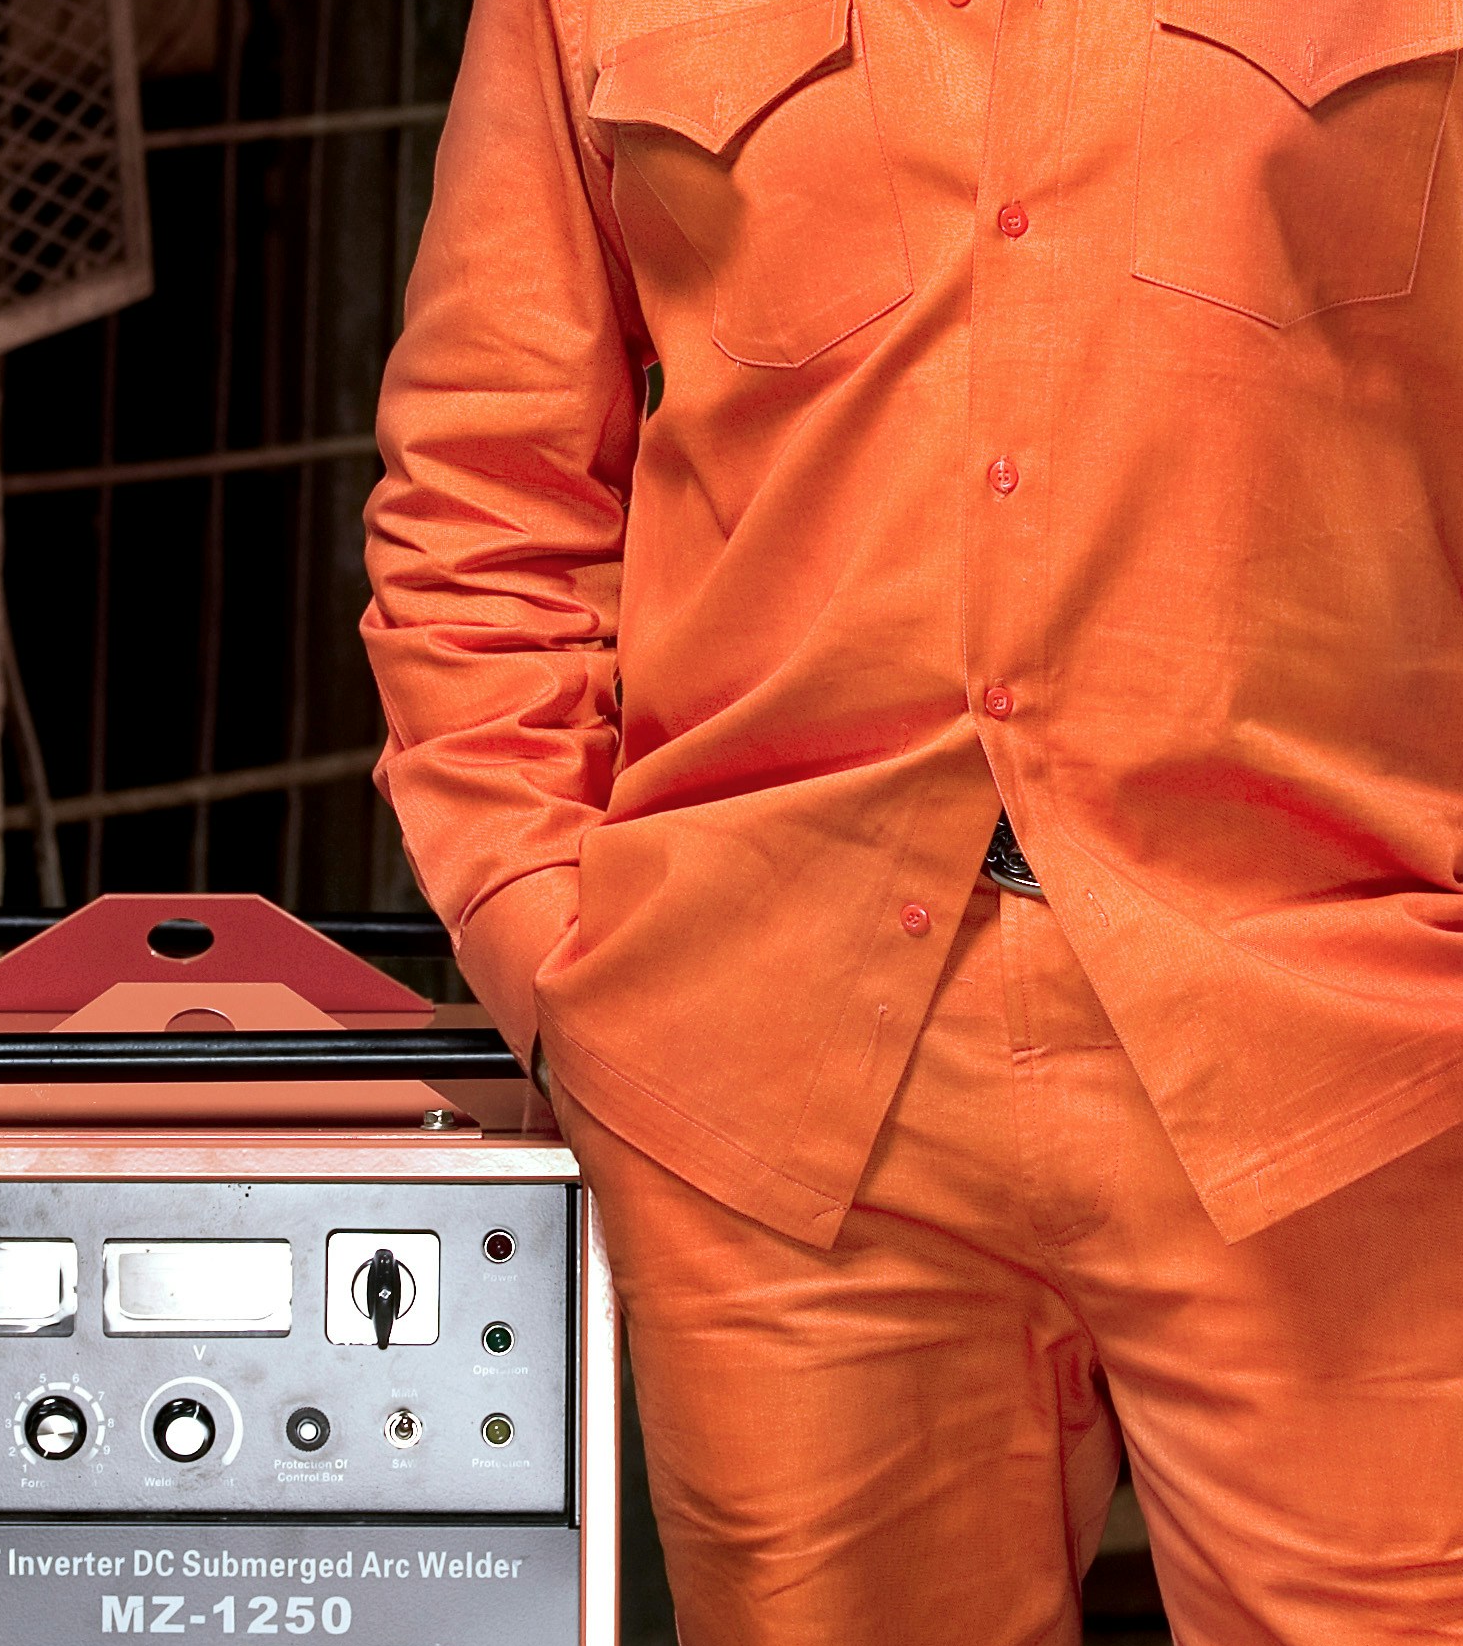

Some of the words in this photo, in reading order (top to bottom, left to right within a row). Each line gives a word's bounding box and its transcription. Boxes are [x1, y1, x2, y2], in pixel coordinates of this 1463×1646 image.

[483, 1274, 517, 1283] Power
[193, 1345, 206, 1360] V
[473, 1365, 528, 1376] Opeion
[39, 1374, 46, 1383] 5
[72, 1374, 79, 1383] 6
[14, 1392, 21, 1400] 4
[98, 1392, 105, 1400] 7
[5, 1419, 12, 1428] 3
[107, 1419, 114, 1428] 8
[9, 1447, 16, 1456] 2
[103, 1446, 110, 1455] 9
[274, 1459, 330, 1469] Protection
[335, 1459, 348, 1469] Of
[277, 1473, 320, 1482] Control
[322, 1473, 344, 1482] Box
[8, 1549, 125, 1577] Inverter
[134, 1549, 174, 1577] DC
[182, 1550, 352, 1584] Submerged
[361, 1551, 410, 1578] Arc
[418, 1551, 522, 1579] Welder
[101, 1594, 352, 1634] MZ-1250
